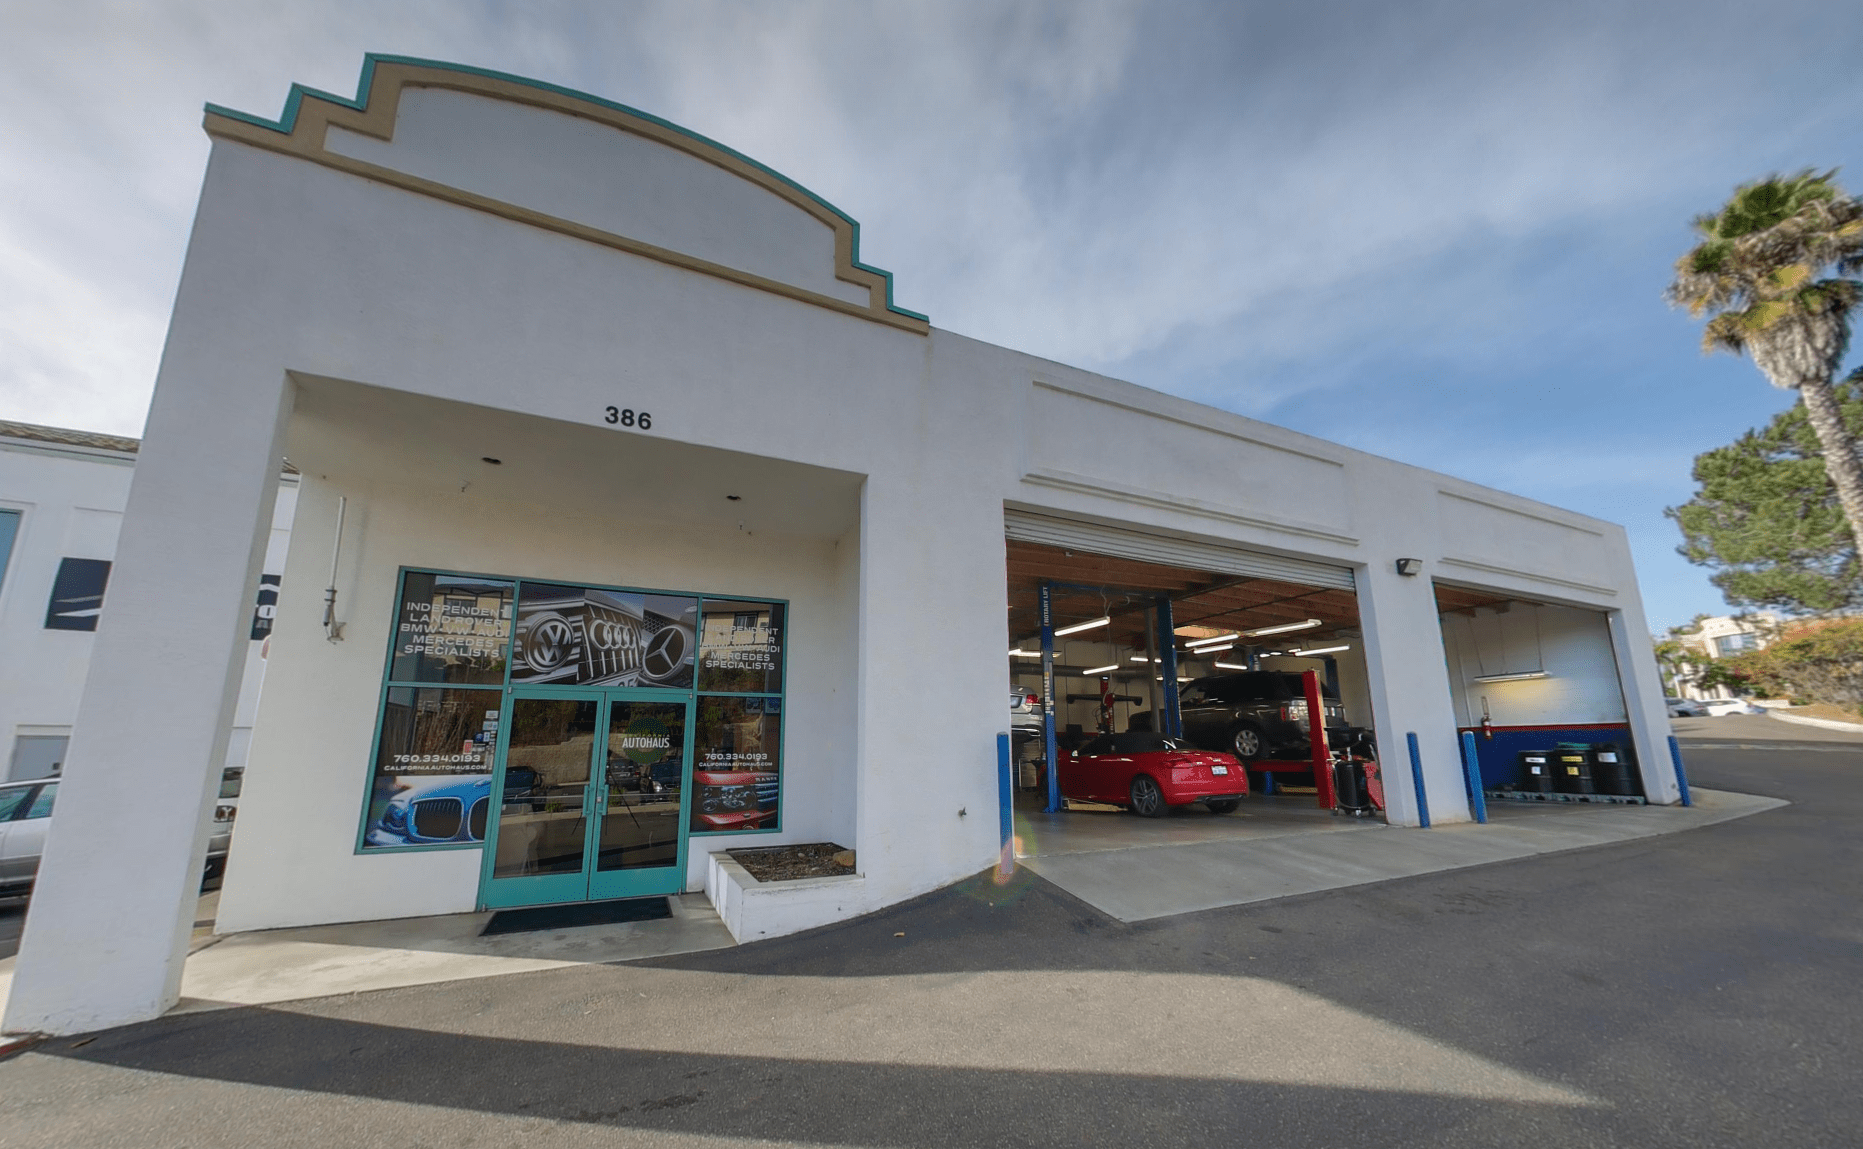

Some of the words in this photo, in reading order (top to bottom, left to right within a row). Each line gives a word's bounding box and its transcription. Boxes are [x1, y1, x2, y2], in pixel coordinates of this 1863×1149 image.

[605, 405, 652, 430] 386
[409, 613, 451, 624] LAND
[454, 616, 504, 628] ROVER
[412, 635, 494, 648] MERCEDES
[404, 645, 500, 658] SPECIALISTS
[710, 651, 771, 662] MERCEDES
[705, 660, 775, 670] SPECIALISTS
[622, 737, 670, 749] AUTOHAUS
[393, 754, 481, 763] 760.334.0193
